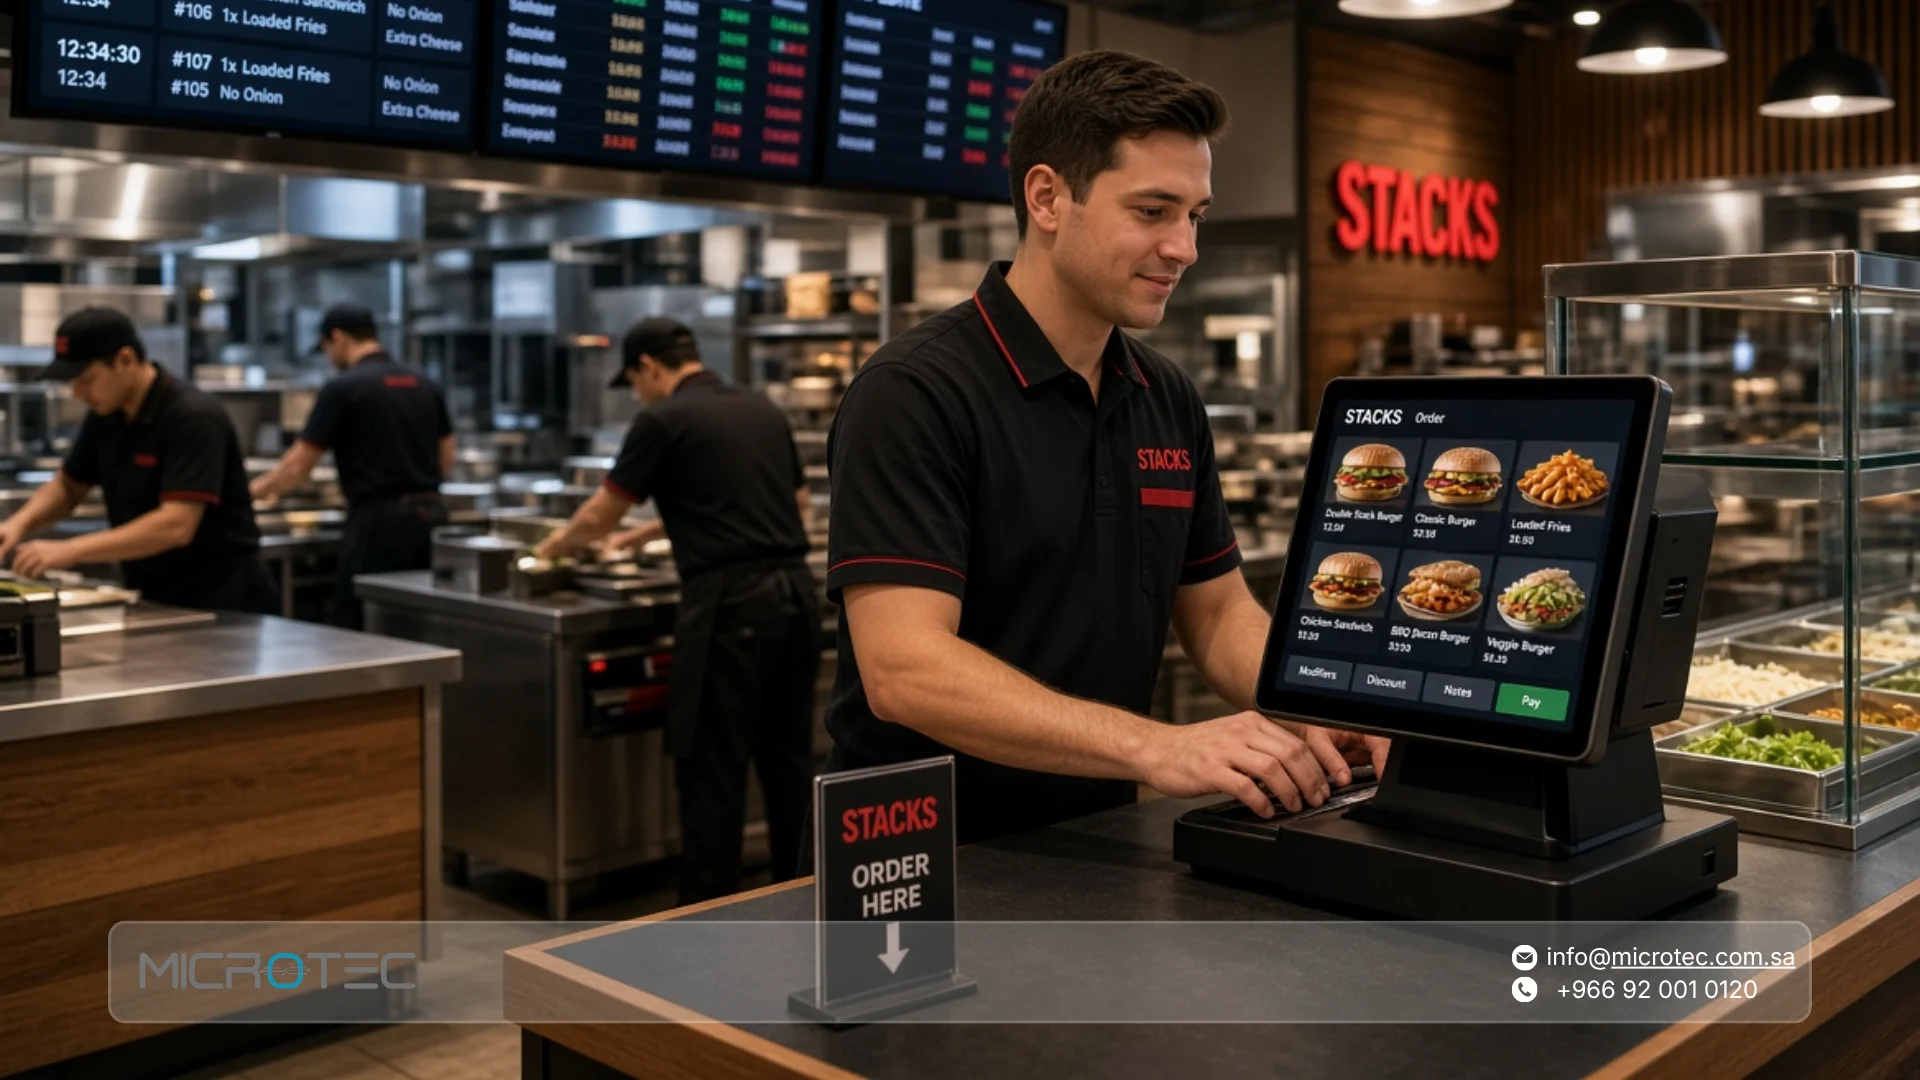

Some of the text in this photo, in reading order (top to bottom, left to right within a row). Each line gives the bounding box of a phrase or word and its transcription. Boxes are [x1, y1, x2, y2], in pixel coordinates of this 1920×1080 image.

[174, 1, 327, 35] #106 1x Loaded Fries
[388, 3, 406, 18] No
[58, 39, 140, 64] 12:34:30
[58, 69, 106, 89] 12:34
[172, 51, 330, 84] #107 1x Loaded Fries
[171, 80, 283, 104] #105 No Onion
[1337, 160, 1499, 260] STACKS
[1345, 409, 1445, 424] STACKS Order
[1137, 448, 1191, 470] STACKS
[1444, 685, 1471, 697] Notes
[1522, 695, 1541, 709] Pay
[842, 795, 938, 844] STACKS
[852, 853, 930, 888] ORDER
[862, 884, 922, 918] HERE
